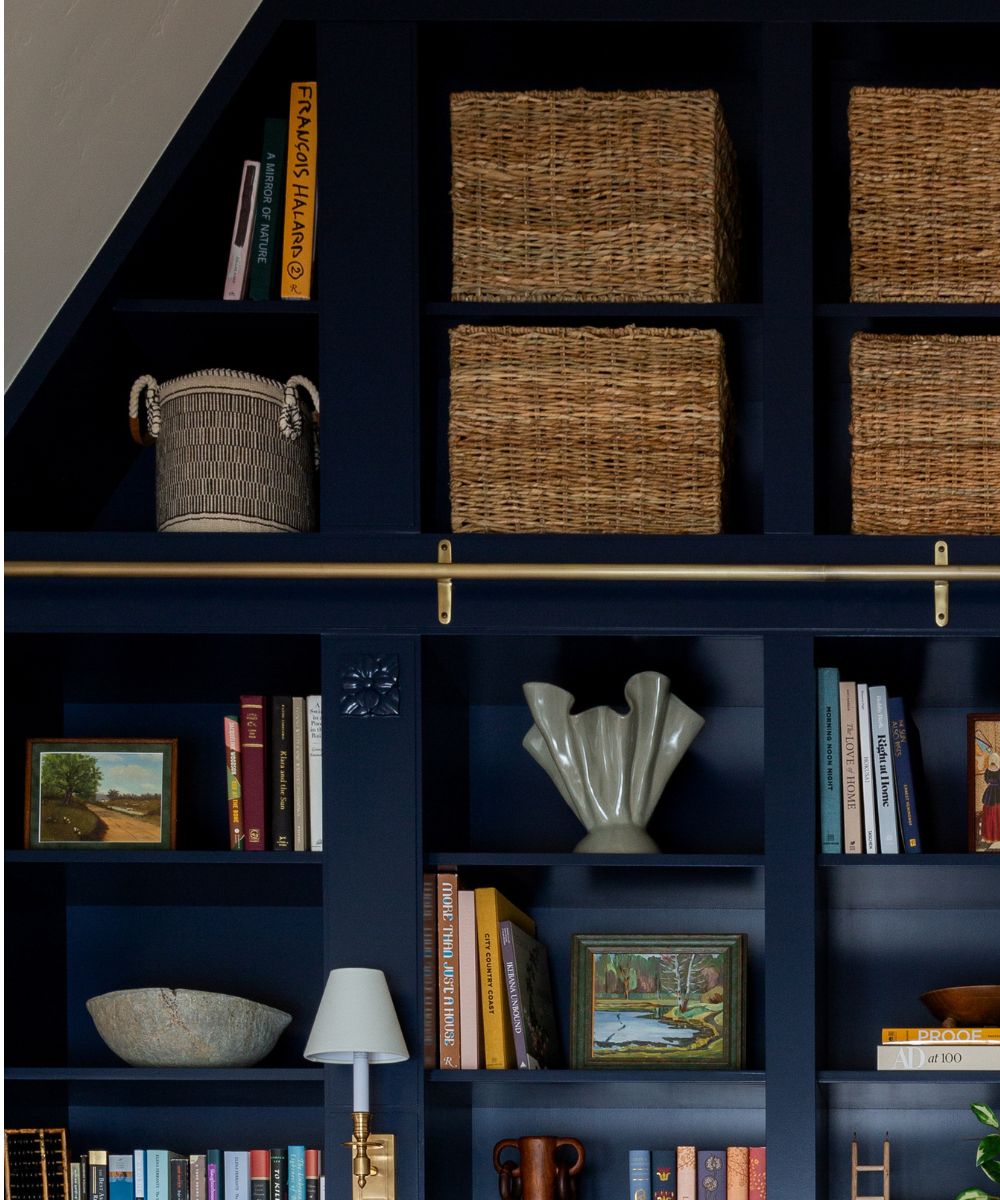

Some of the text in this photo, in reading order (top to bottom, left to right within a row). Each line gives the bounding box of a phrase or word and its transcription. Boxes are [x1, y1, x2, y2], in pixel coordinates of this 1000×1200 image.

[263, 162, 275, 204] MIRROR
[291, 86, 312, 258] FRANÇOIS HALARD
[262, 206, 271, 220] OF
[258, 224, 270, 264] NATURE
[846, 737, 855, 765] LOVE
[876, 734, 890, 808] Right at Home
[847, 776, 856, 810] HOME
[442, 882, 454, 1046] MORE THAN JUST A HOUSE
[506, 961, 522, 1034] IKEBANA UNBOUND
[918, 1030, 982, 1041] PROOF
[892, 1046, 963, 1070] AD at 100
[275, 1169, 280, 1180] TO
